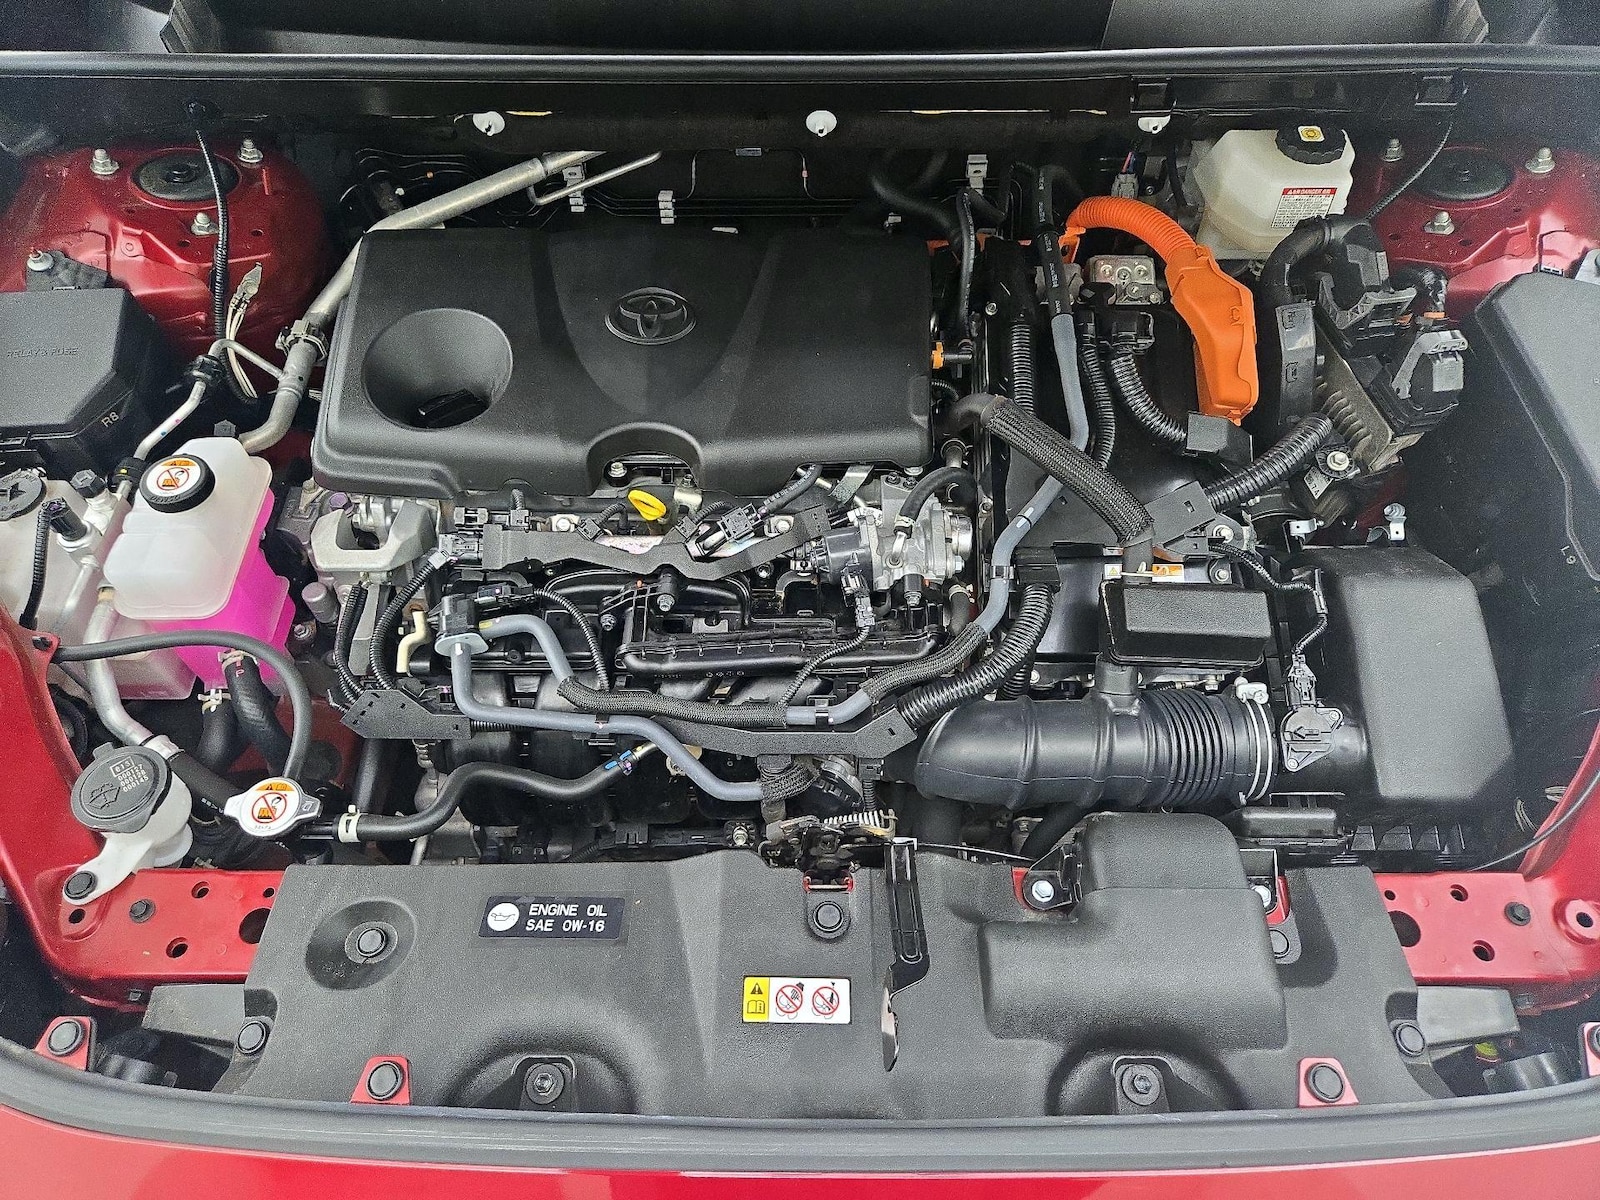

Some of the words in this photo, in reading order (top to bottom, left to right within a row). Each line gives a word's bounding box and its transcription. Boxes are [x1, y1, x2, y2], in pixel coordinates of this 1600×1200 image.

[7, 349, 40, 358] RELAY
[51, 347, 79, 356] FUSE
[101, 411, 119, 428] R8
[117, 763, 144, 781] 000127
[119, 769, 147, 787] 000128
[122, 776, 149, 793] 000145
[529, 903, 579, 916] ENGINE
[586, 904, 608, 917] OIL
[525, 919, 555, 932] SAE
[562, 919, 605, 932] 0W-16
